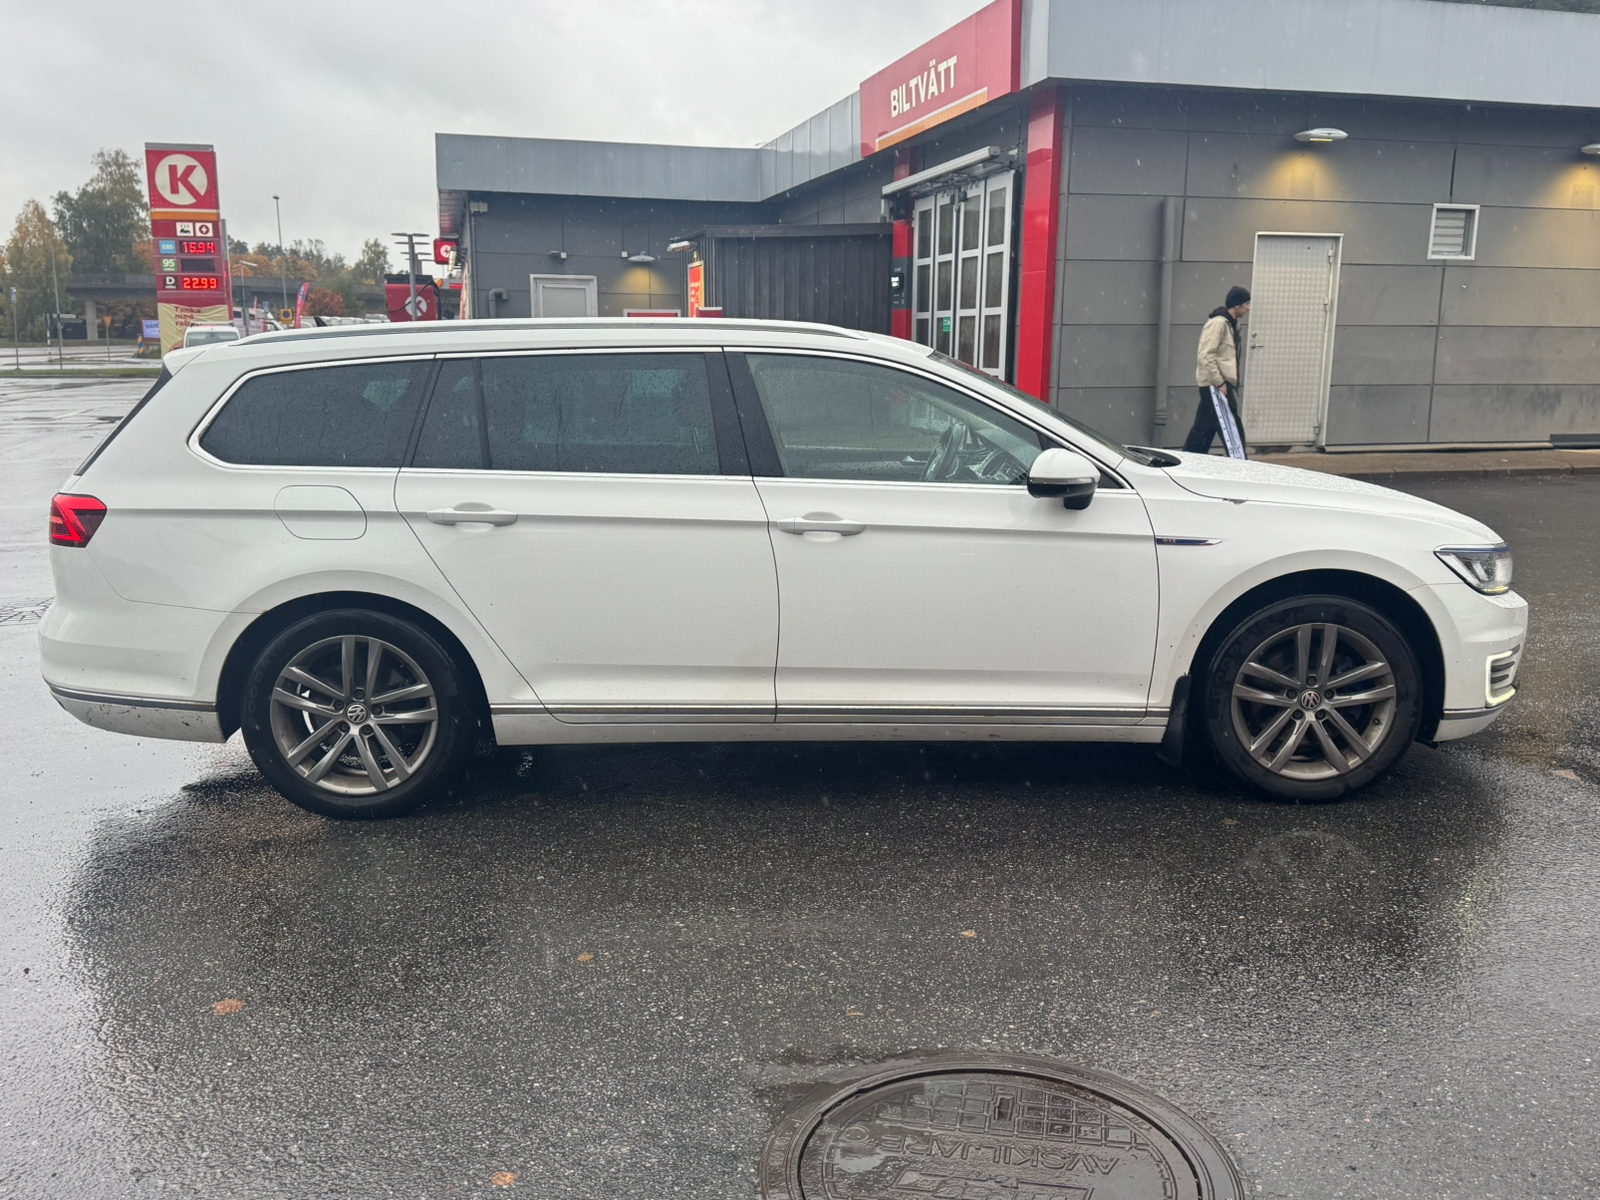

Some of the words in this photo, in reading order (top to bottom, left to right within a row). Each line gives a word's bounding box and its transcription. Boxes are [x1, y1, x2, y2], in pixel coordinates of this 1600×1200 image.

[890, 55, 957, 118] BILTVÄTT
[168, 164, 203, 202] K
[162, 258, 175, 267] 95
[165, 276, 175, 285] D
[174, 306, 202, 314] Tanka
[883, 1133, 1120, 1174] AVSKILJARE
